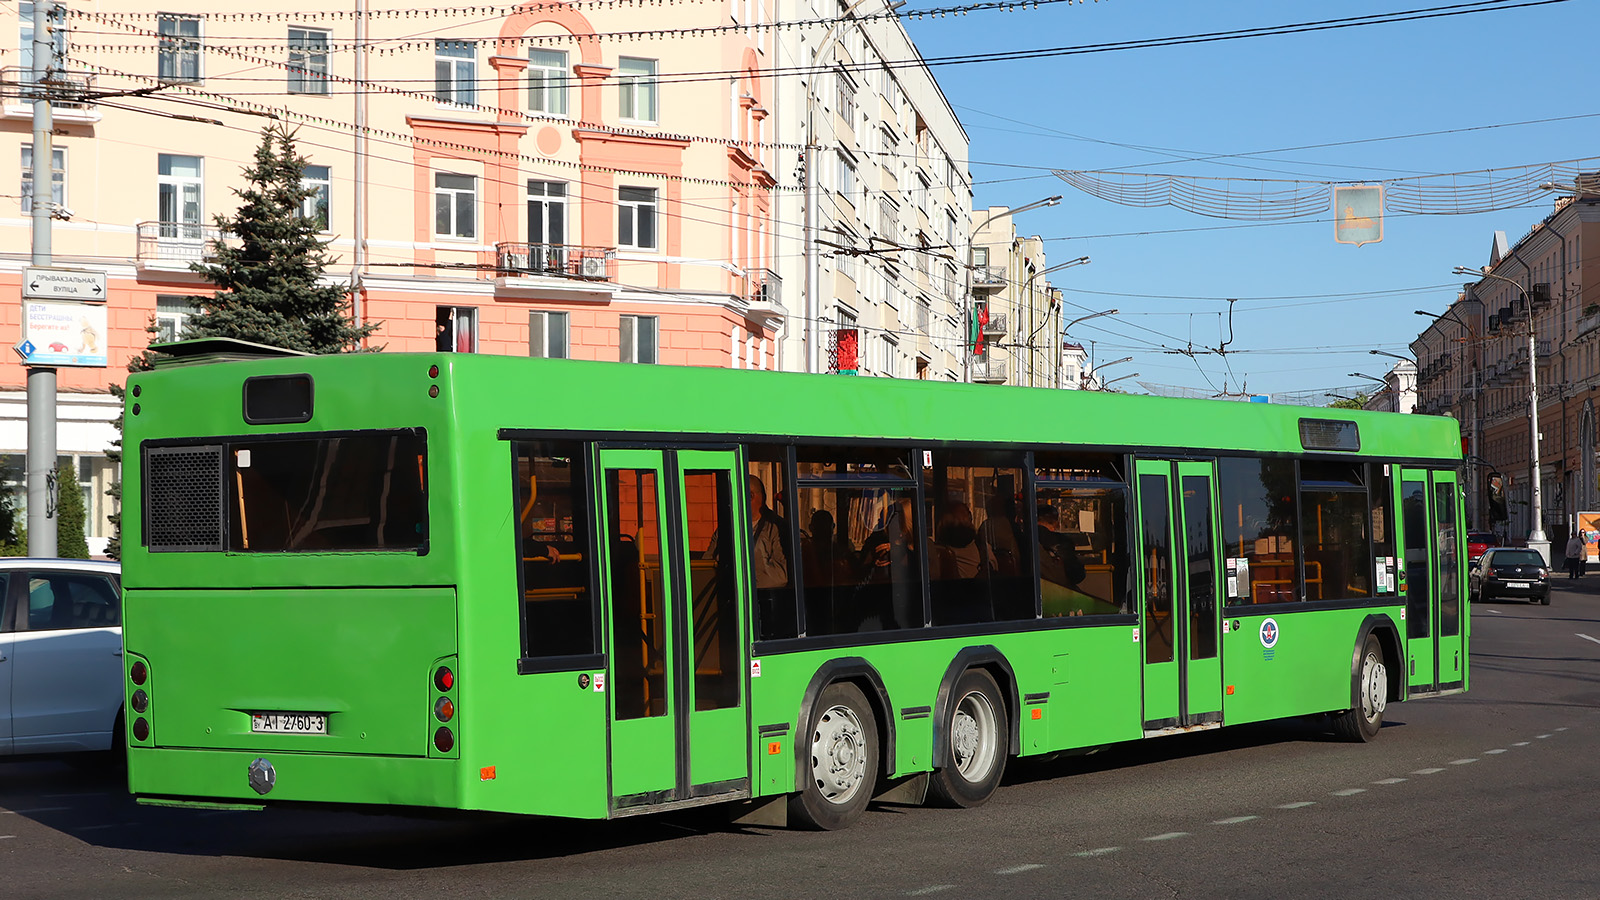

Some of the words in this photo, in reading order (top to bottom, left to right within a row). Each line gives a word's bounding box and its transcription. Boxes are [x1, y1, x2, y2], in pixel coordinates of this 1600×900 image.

[36, 275, 96, 283] ПРЫВАКЗАЛЬНАЯ
[29, 304, 46, 312] ДЕТИ
[29, 322, 59, 331] Берегите
[283, 714, 324, 731] 2760-3
